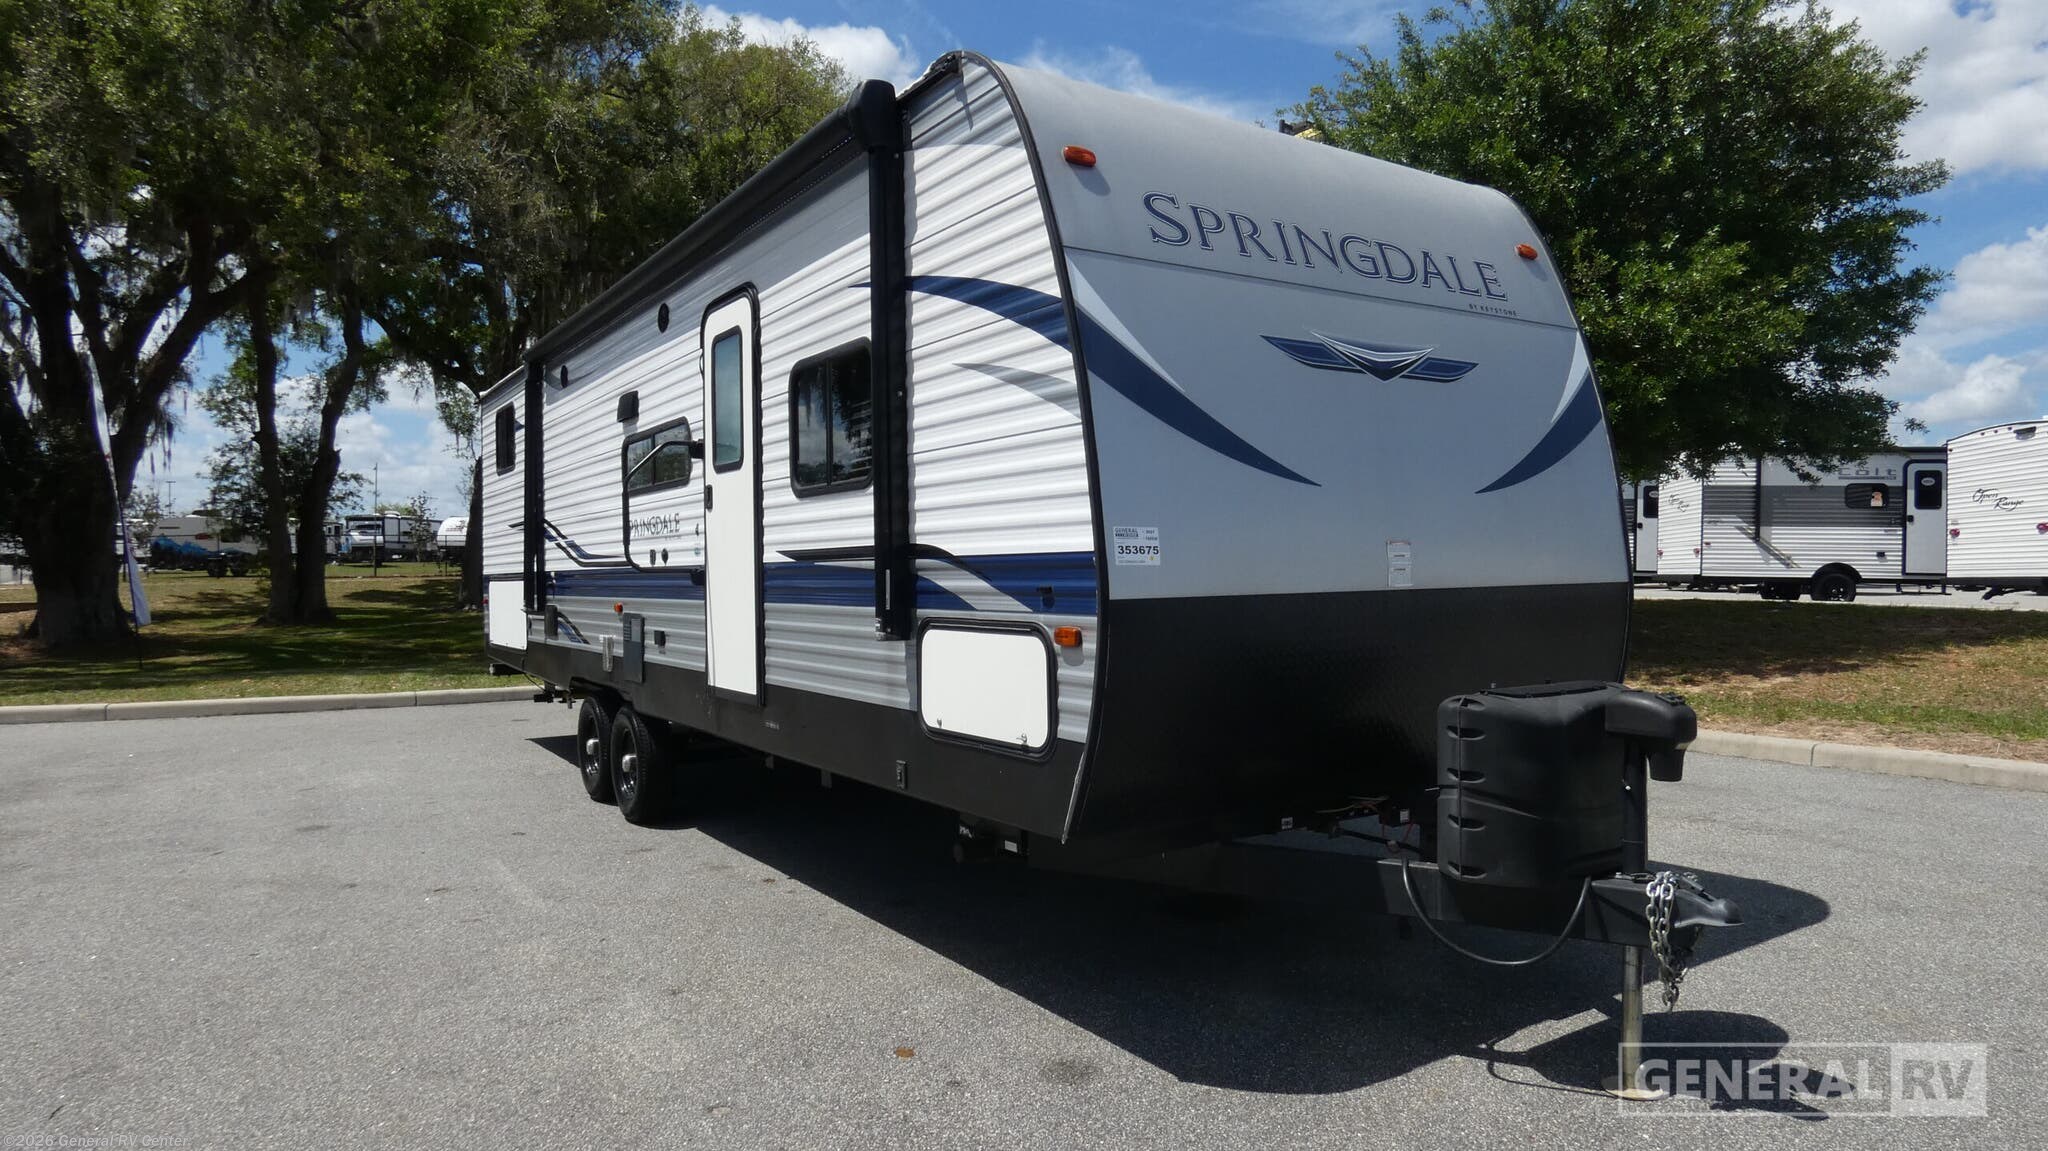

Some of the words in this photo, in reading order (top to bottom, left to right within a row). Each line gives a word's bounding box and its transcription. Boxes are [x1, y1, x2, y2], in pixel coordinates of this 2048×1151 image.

[1142, 190, 1508, 301] SPRINGDALE
[629, 513, 681, 537] PRINGDALE
[1117, 545, 1160, 555] 353675
